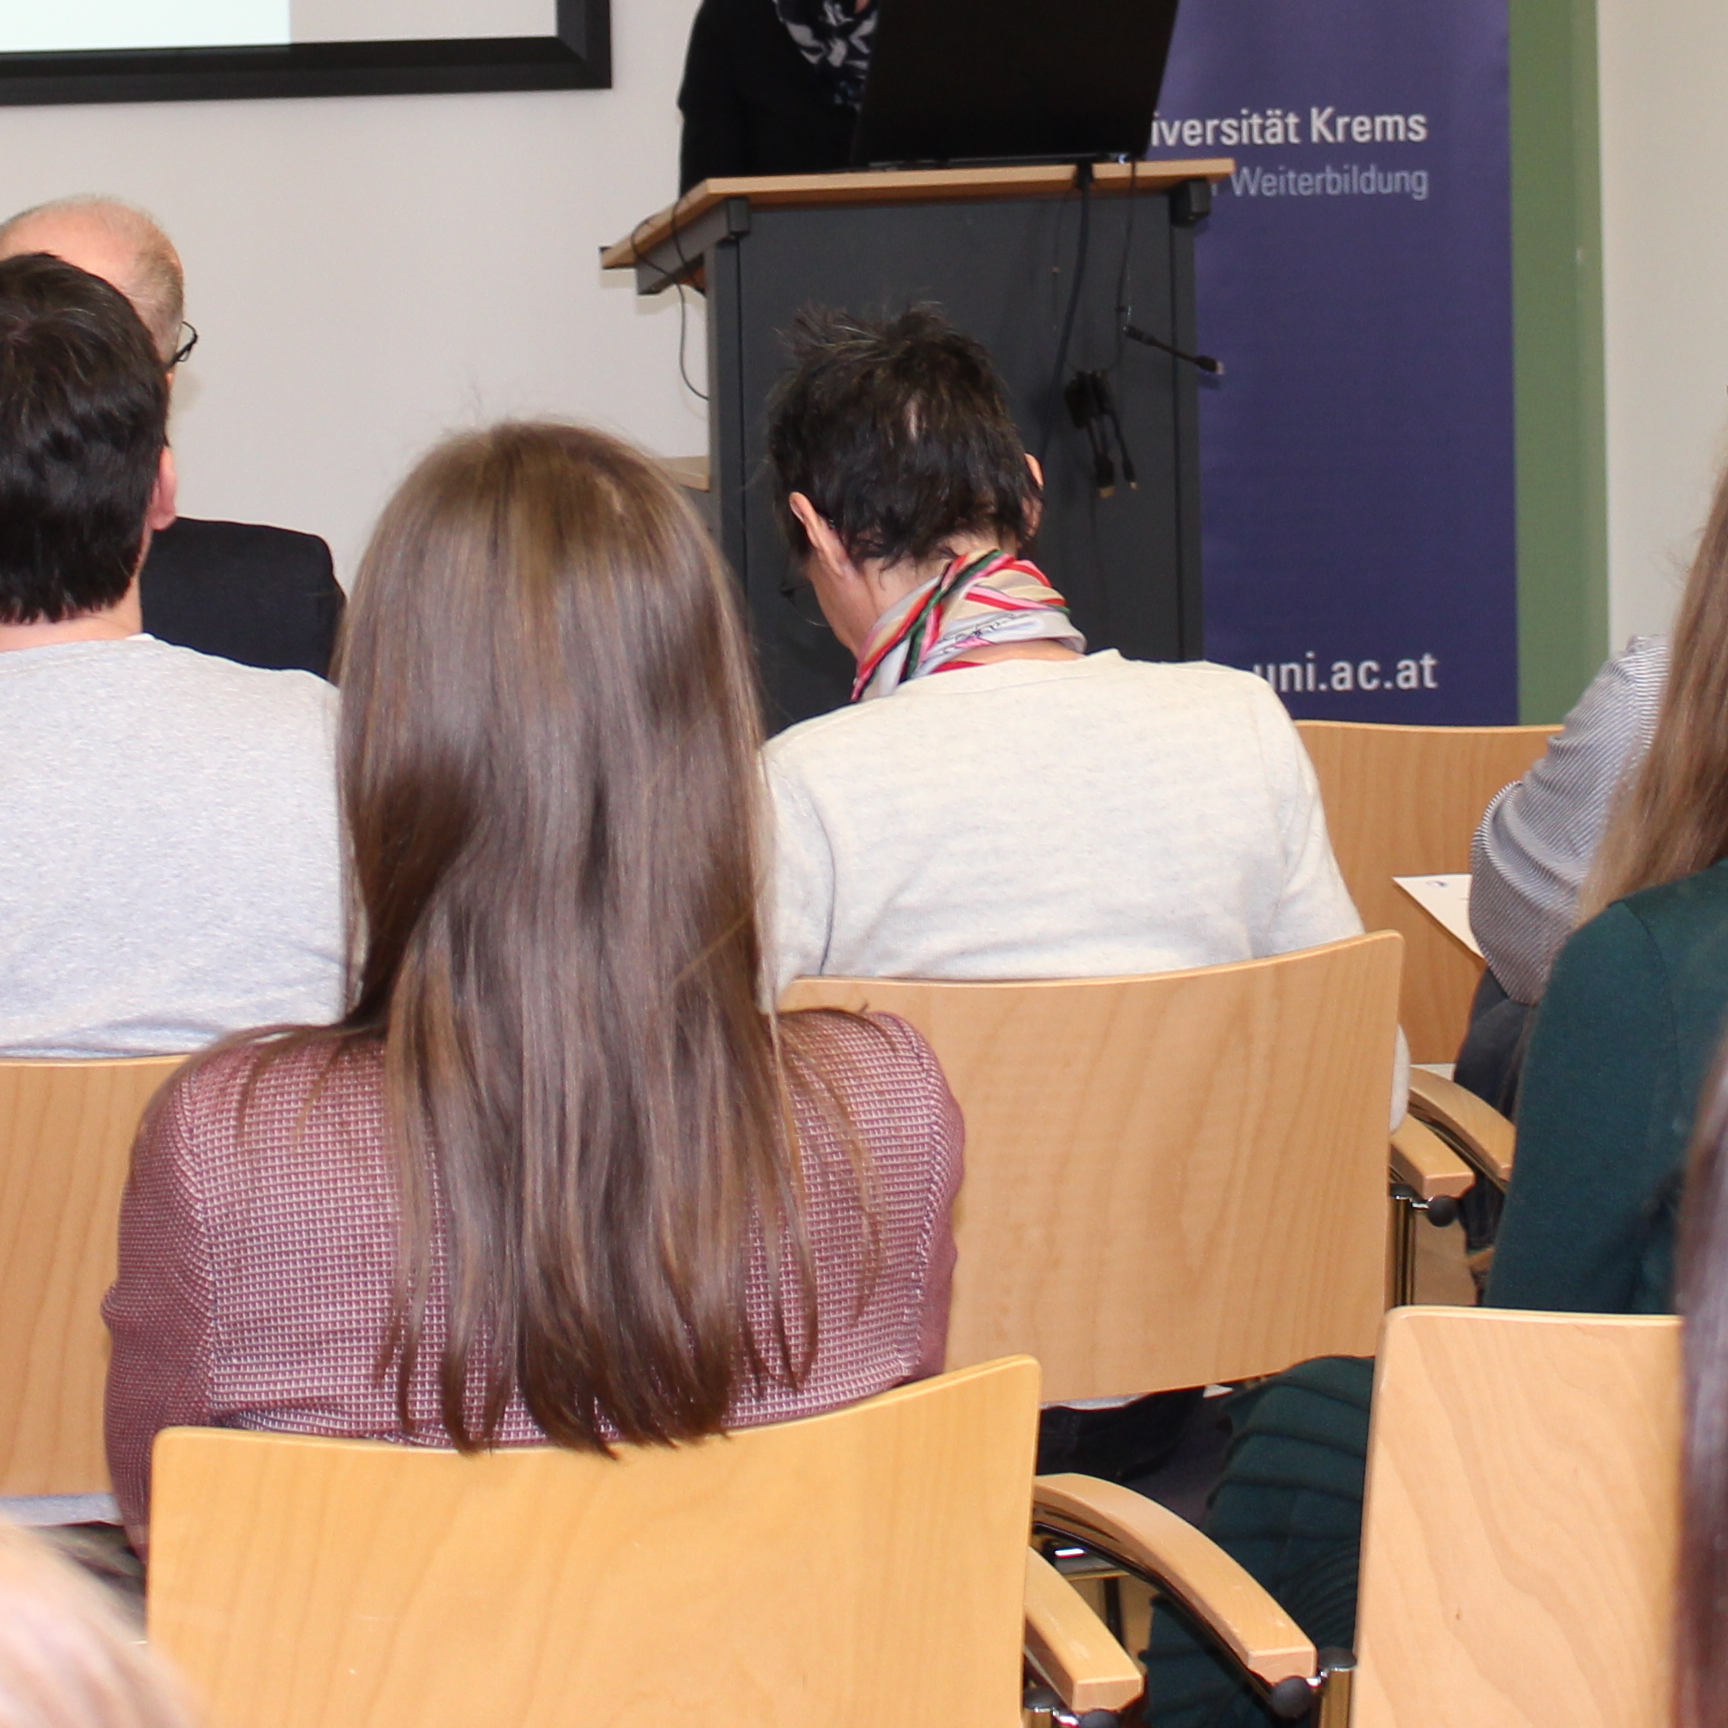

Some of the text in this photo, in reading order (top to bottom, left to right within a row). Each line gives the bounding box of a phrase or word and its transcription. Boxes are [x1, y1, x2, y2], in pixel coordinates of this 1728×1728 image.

[1150, 106, 1429, 147] iversität Krems
[1231, 163, 1429, 201] Weiterbildung
